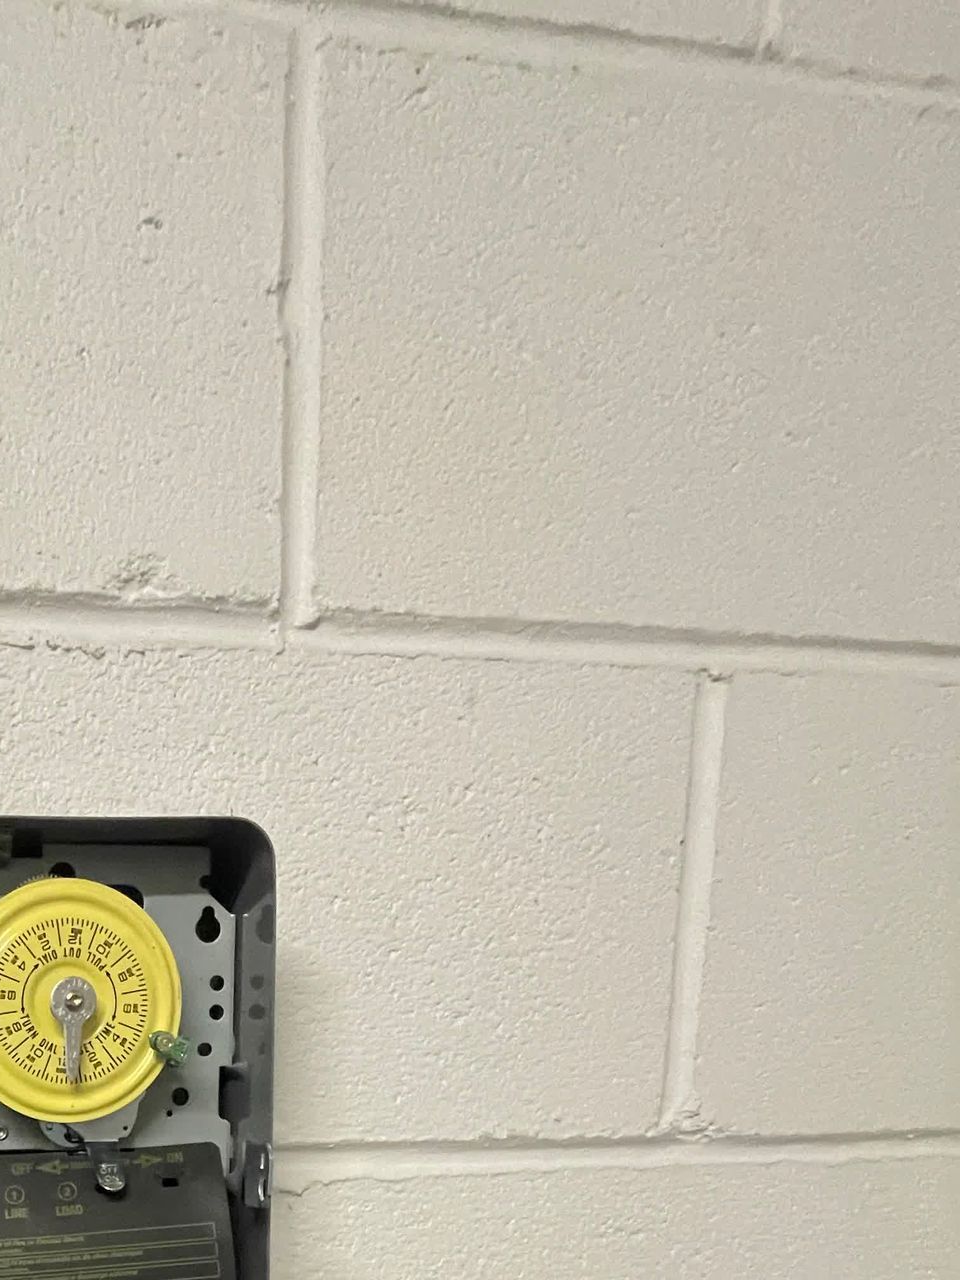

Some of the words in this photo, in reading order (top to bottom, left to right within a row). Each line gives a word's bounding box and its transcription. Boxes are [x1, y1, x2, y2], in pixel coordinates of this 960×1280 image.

[36, 950, 58, 966] DIAL
[63, 947, 81, 958] OUT
[85, 951, 109, 972] PULL
[19, 1014, 39, 1040] TURN
[38, 1038, 58, 1055] DIAL
[95, 1021, 116, 1045] TIME
[11, 1162, 34, 1176] OFF
[4, 1207, 29, 1220] LINE
[55, 1203, 84, 1217] LOAD
